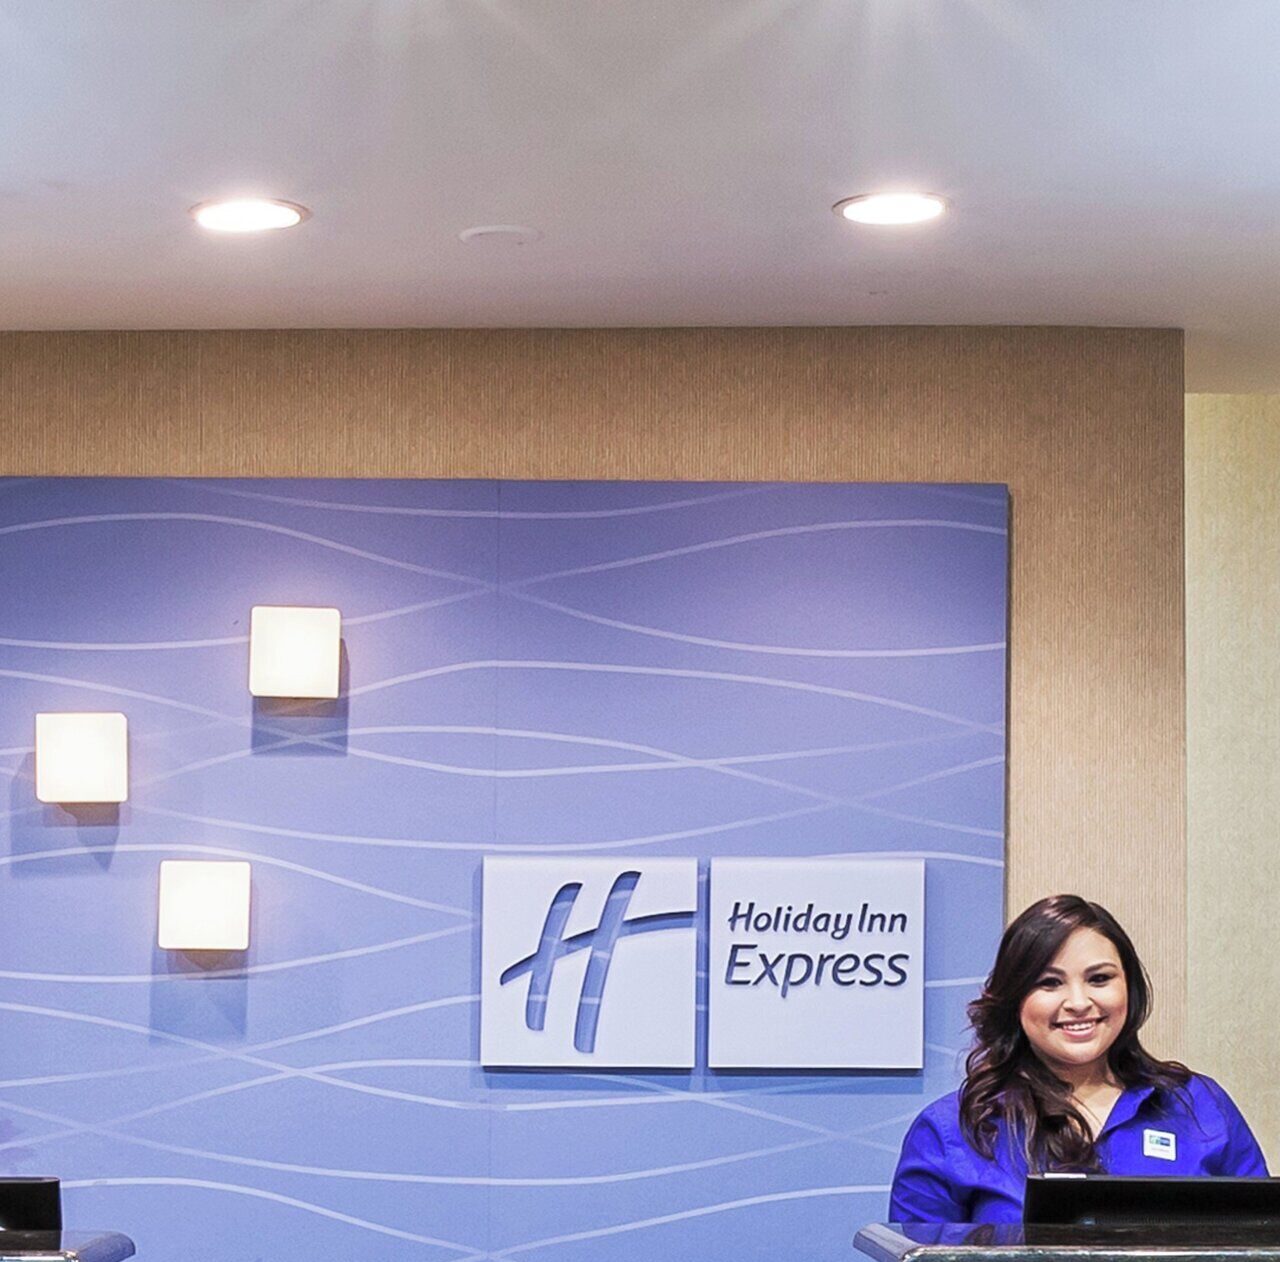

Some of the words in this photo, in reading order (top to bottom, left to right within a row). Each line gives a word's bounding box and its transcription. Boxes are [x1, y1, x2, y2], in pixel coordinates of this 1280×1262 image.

[727, 902, 853, 940] Holiday
[858, 903, 907, 933] Inn
[725, 944, 909, 998] Express
